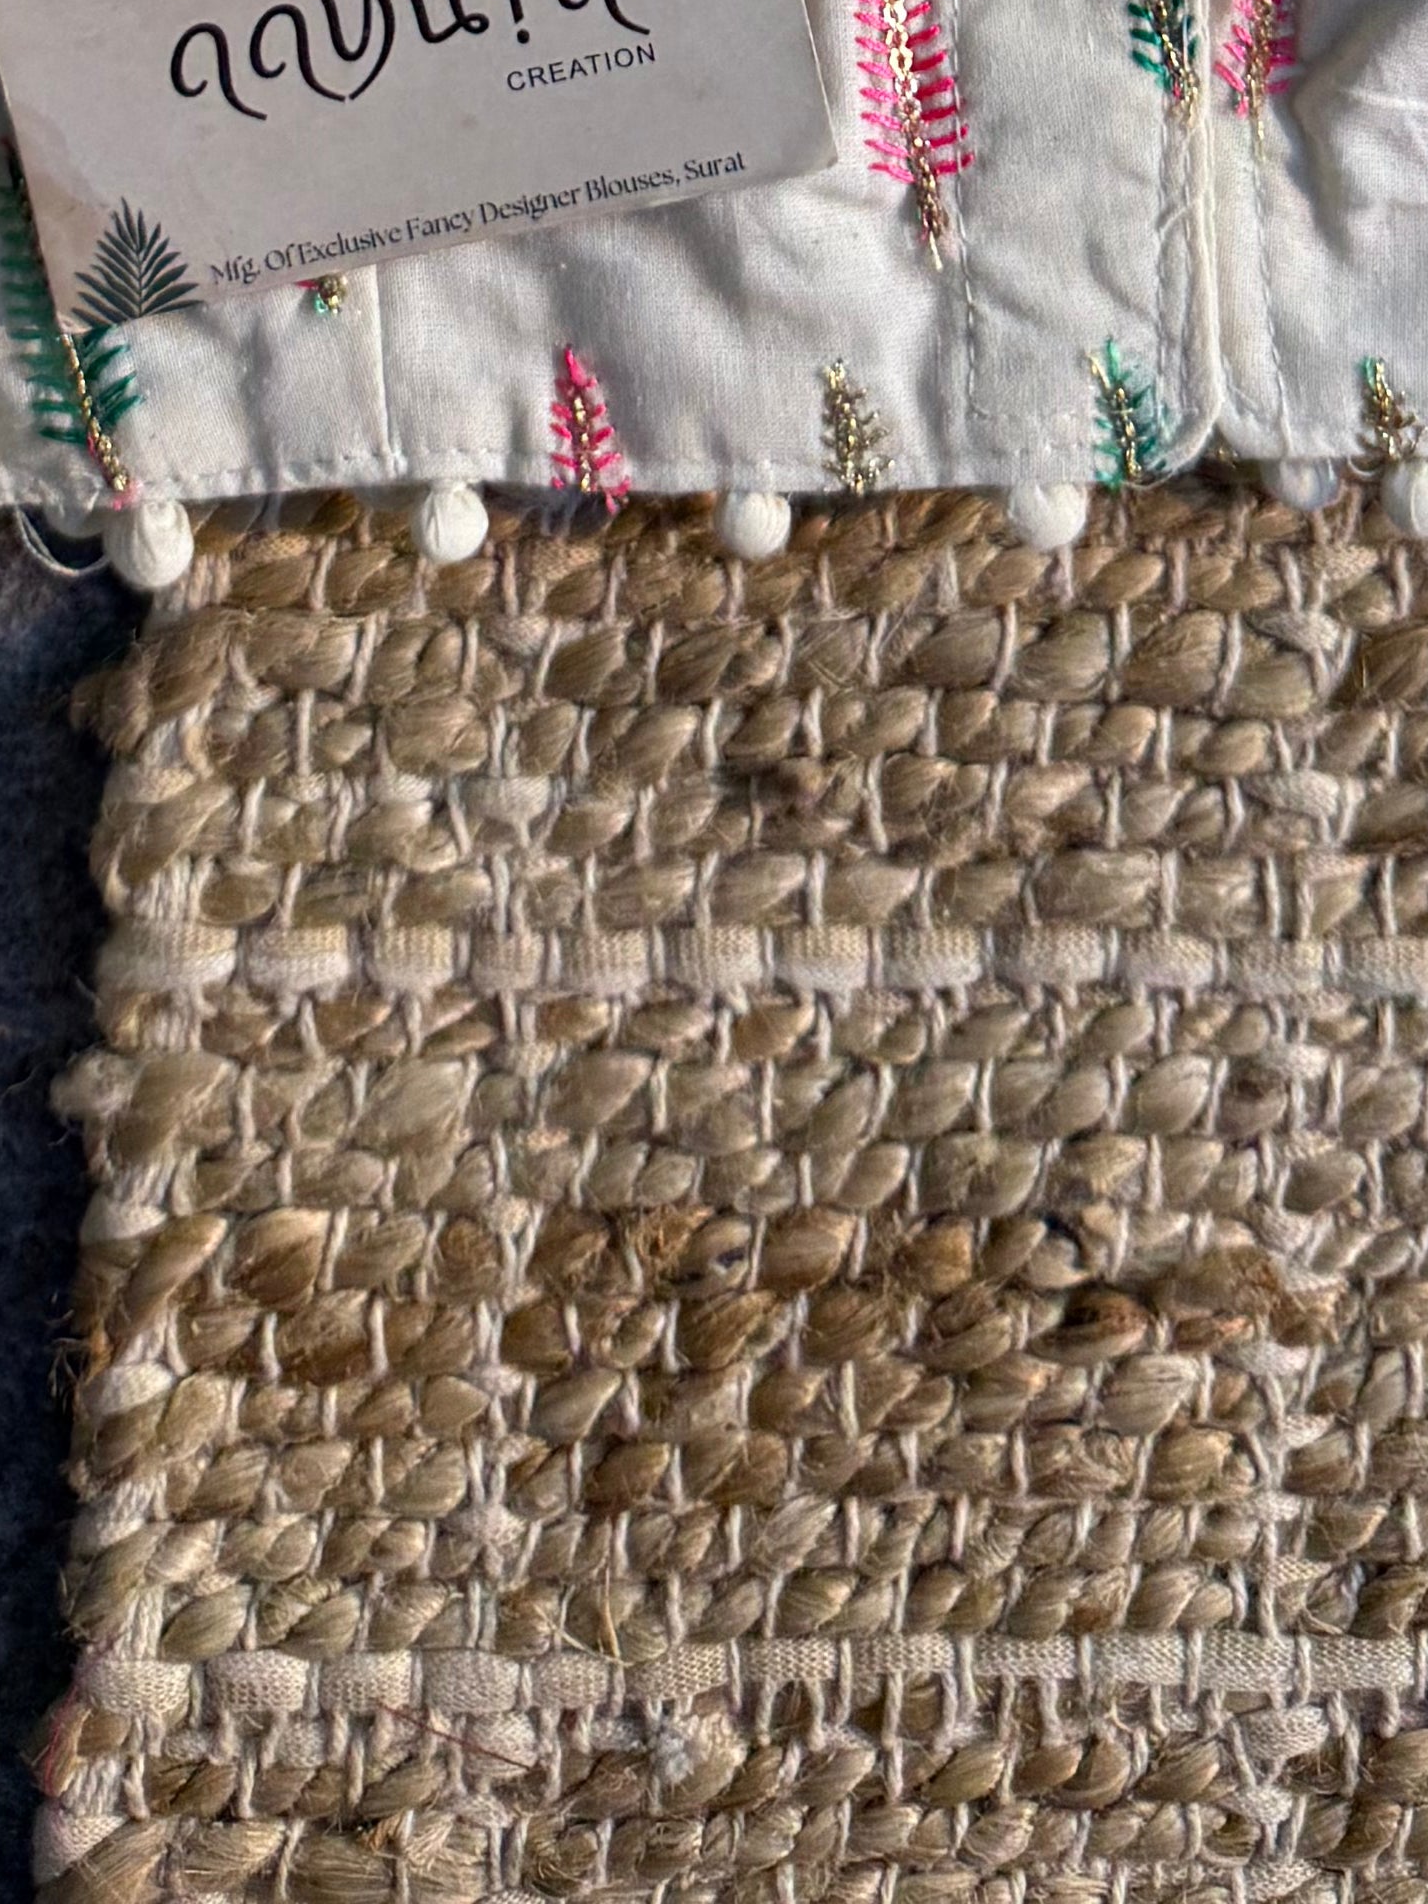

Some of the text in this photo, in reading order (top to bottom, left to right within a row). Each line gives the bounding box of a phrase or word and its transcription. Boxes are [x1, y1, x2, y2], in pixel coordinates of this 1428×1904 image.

[505, 41, 657, 93] CREATION
[207, 149, 747, 289] Mfg. Of Exclusive Fancy Designer Blouses, Surat
